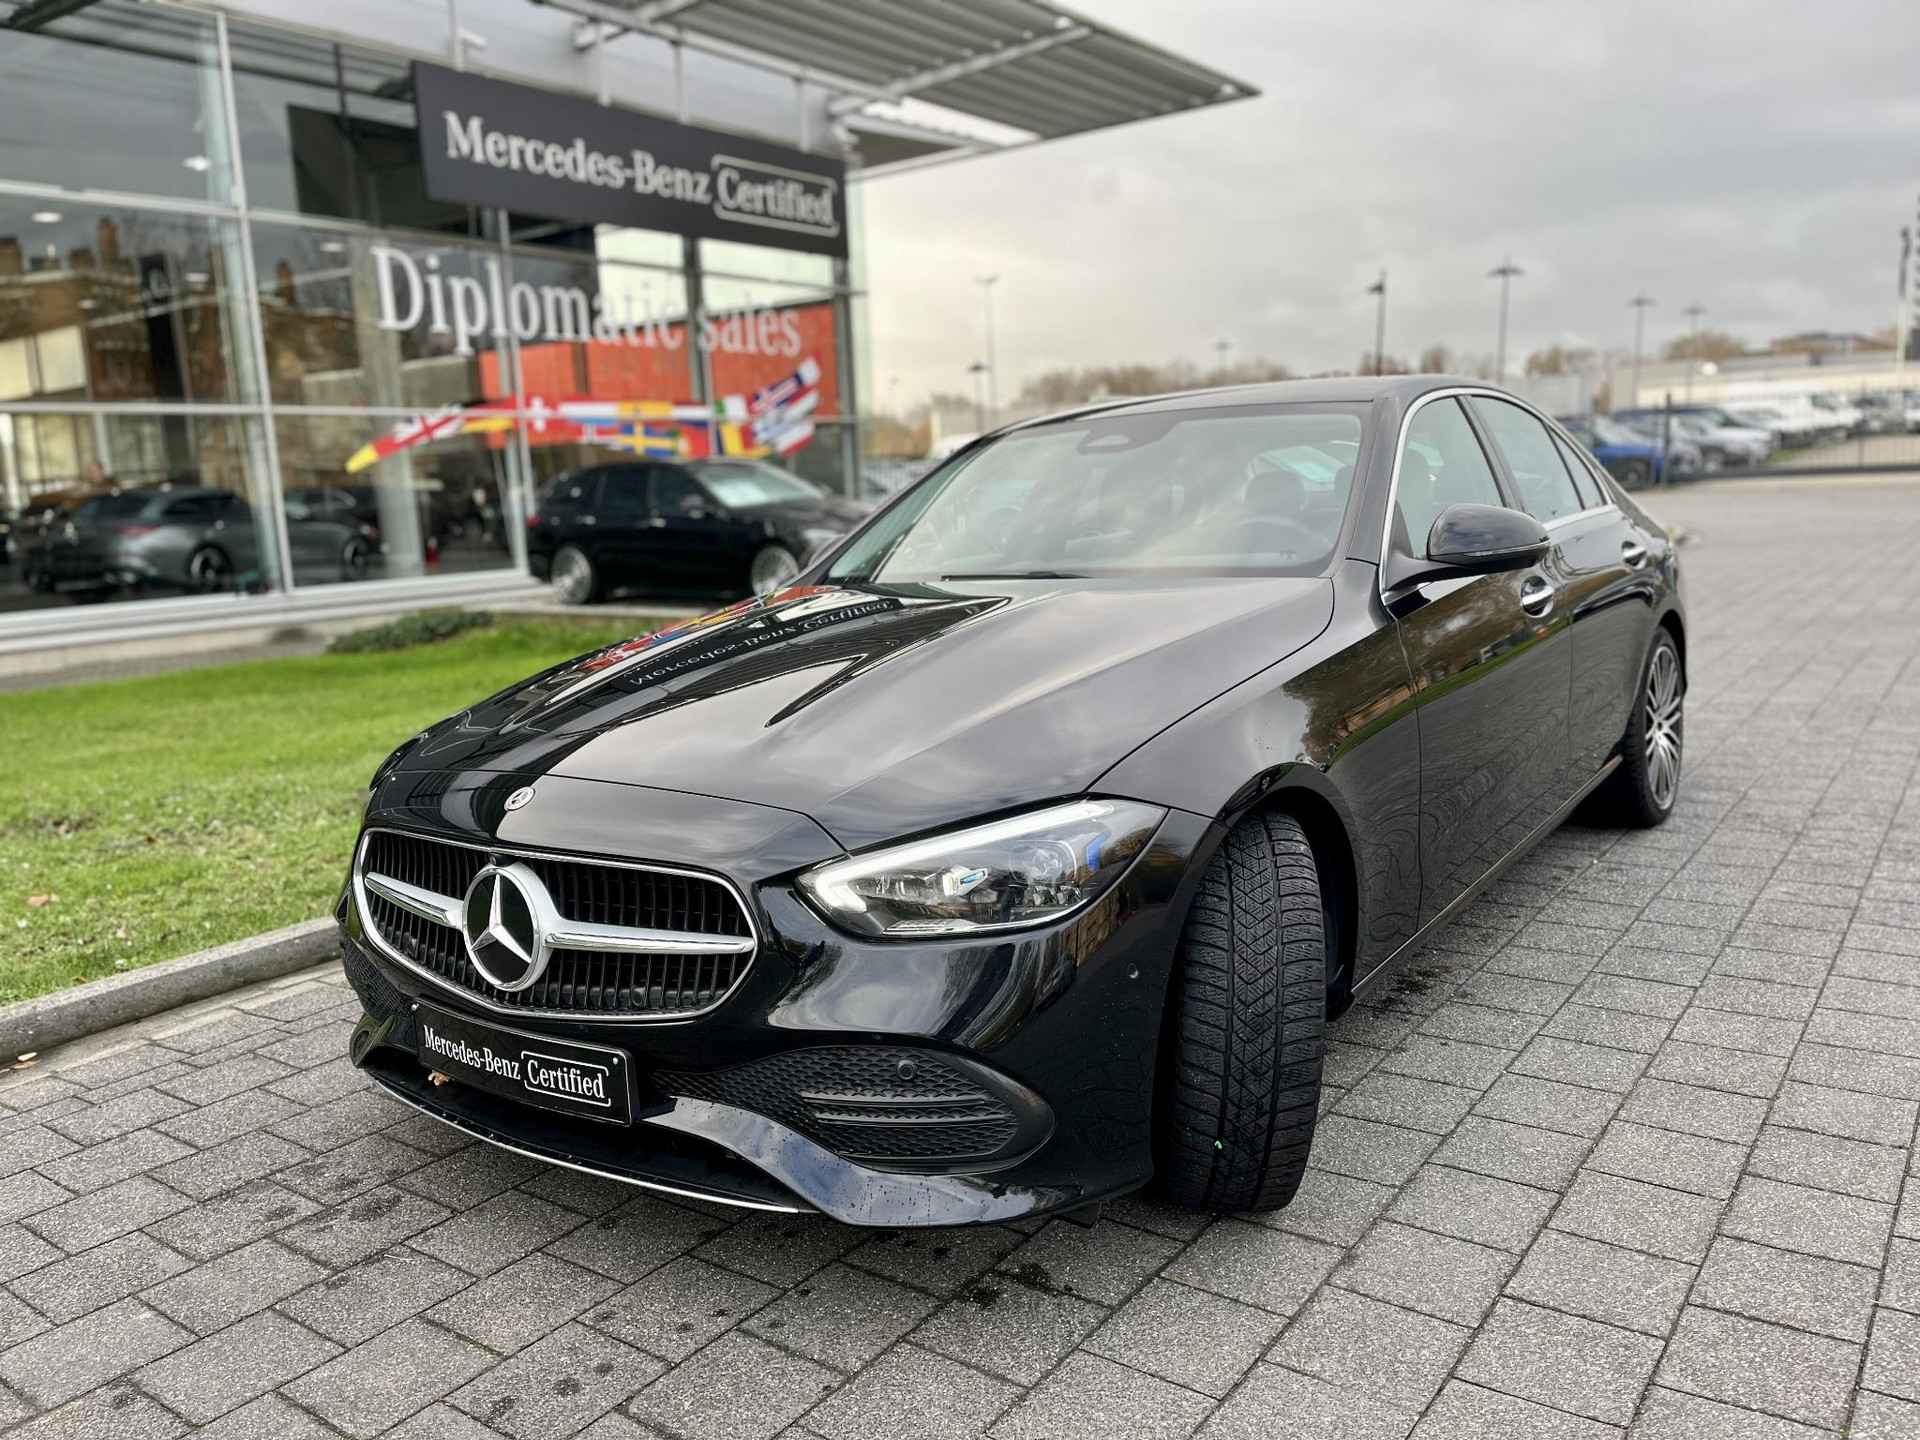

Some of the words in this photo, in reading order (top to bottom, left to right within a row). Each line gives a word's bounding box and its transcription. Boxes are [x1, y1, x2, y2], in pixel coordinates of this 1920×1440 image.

[443, 110, 711, 204] Mercedes-Benz
[717, 168, 834, 226] Certified
[371, 246, 683, 356] Diplomatic
[423, 1025, 521, 1080] Mercedes-Benz
[527, 1059, 605, 1098] Certified
